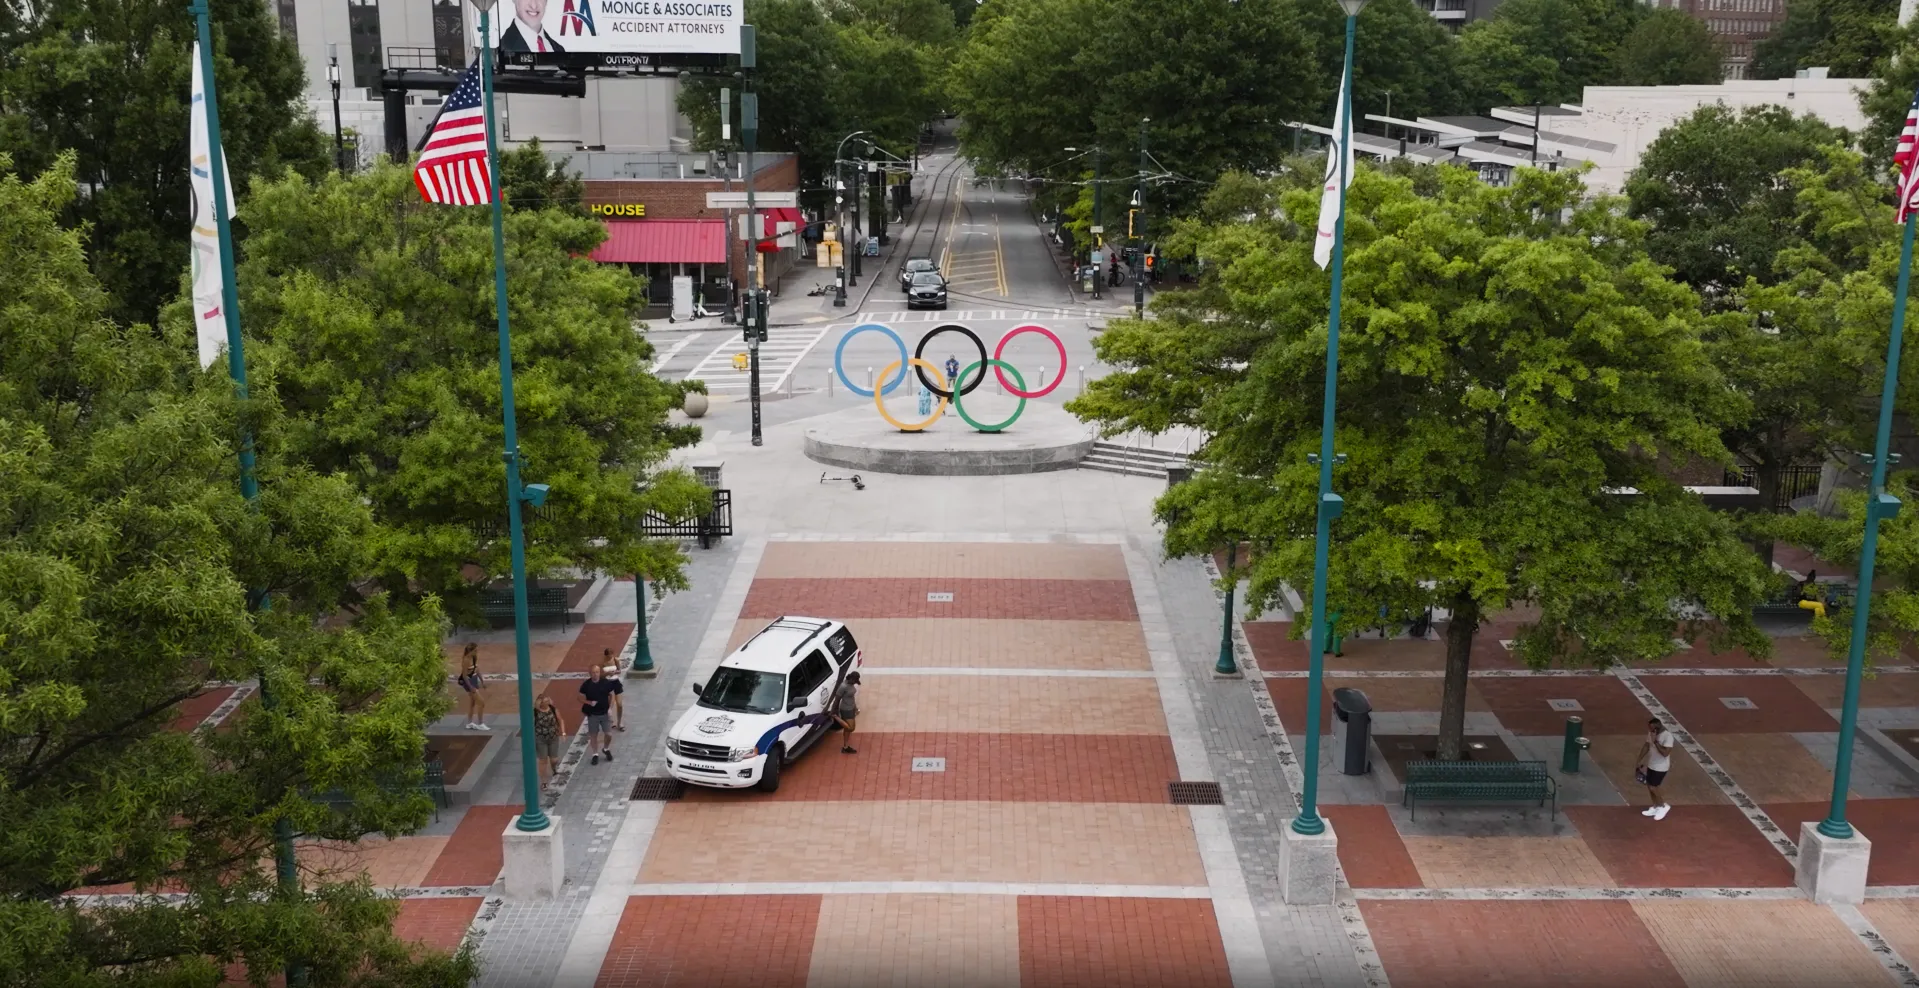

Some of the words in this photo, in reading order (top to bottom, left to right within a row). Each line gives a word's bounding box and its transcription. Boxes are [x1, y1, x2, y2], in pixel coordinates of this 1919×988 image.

[601, 0, 650, 15] MONGE
[653, 2, 663, 15] &
[664, 2, 733, 17] ASSOCIATES
[612, 21, 665, 33] ACCIDENT
[667, 22, 725, 34] ATTORNEYS
[591, 203, 646, 216] HOUSE
